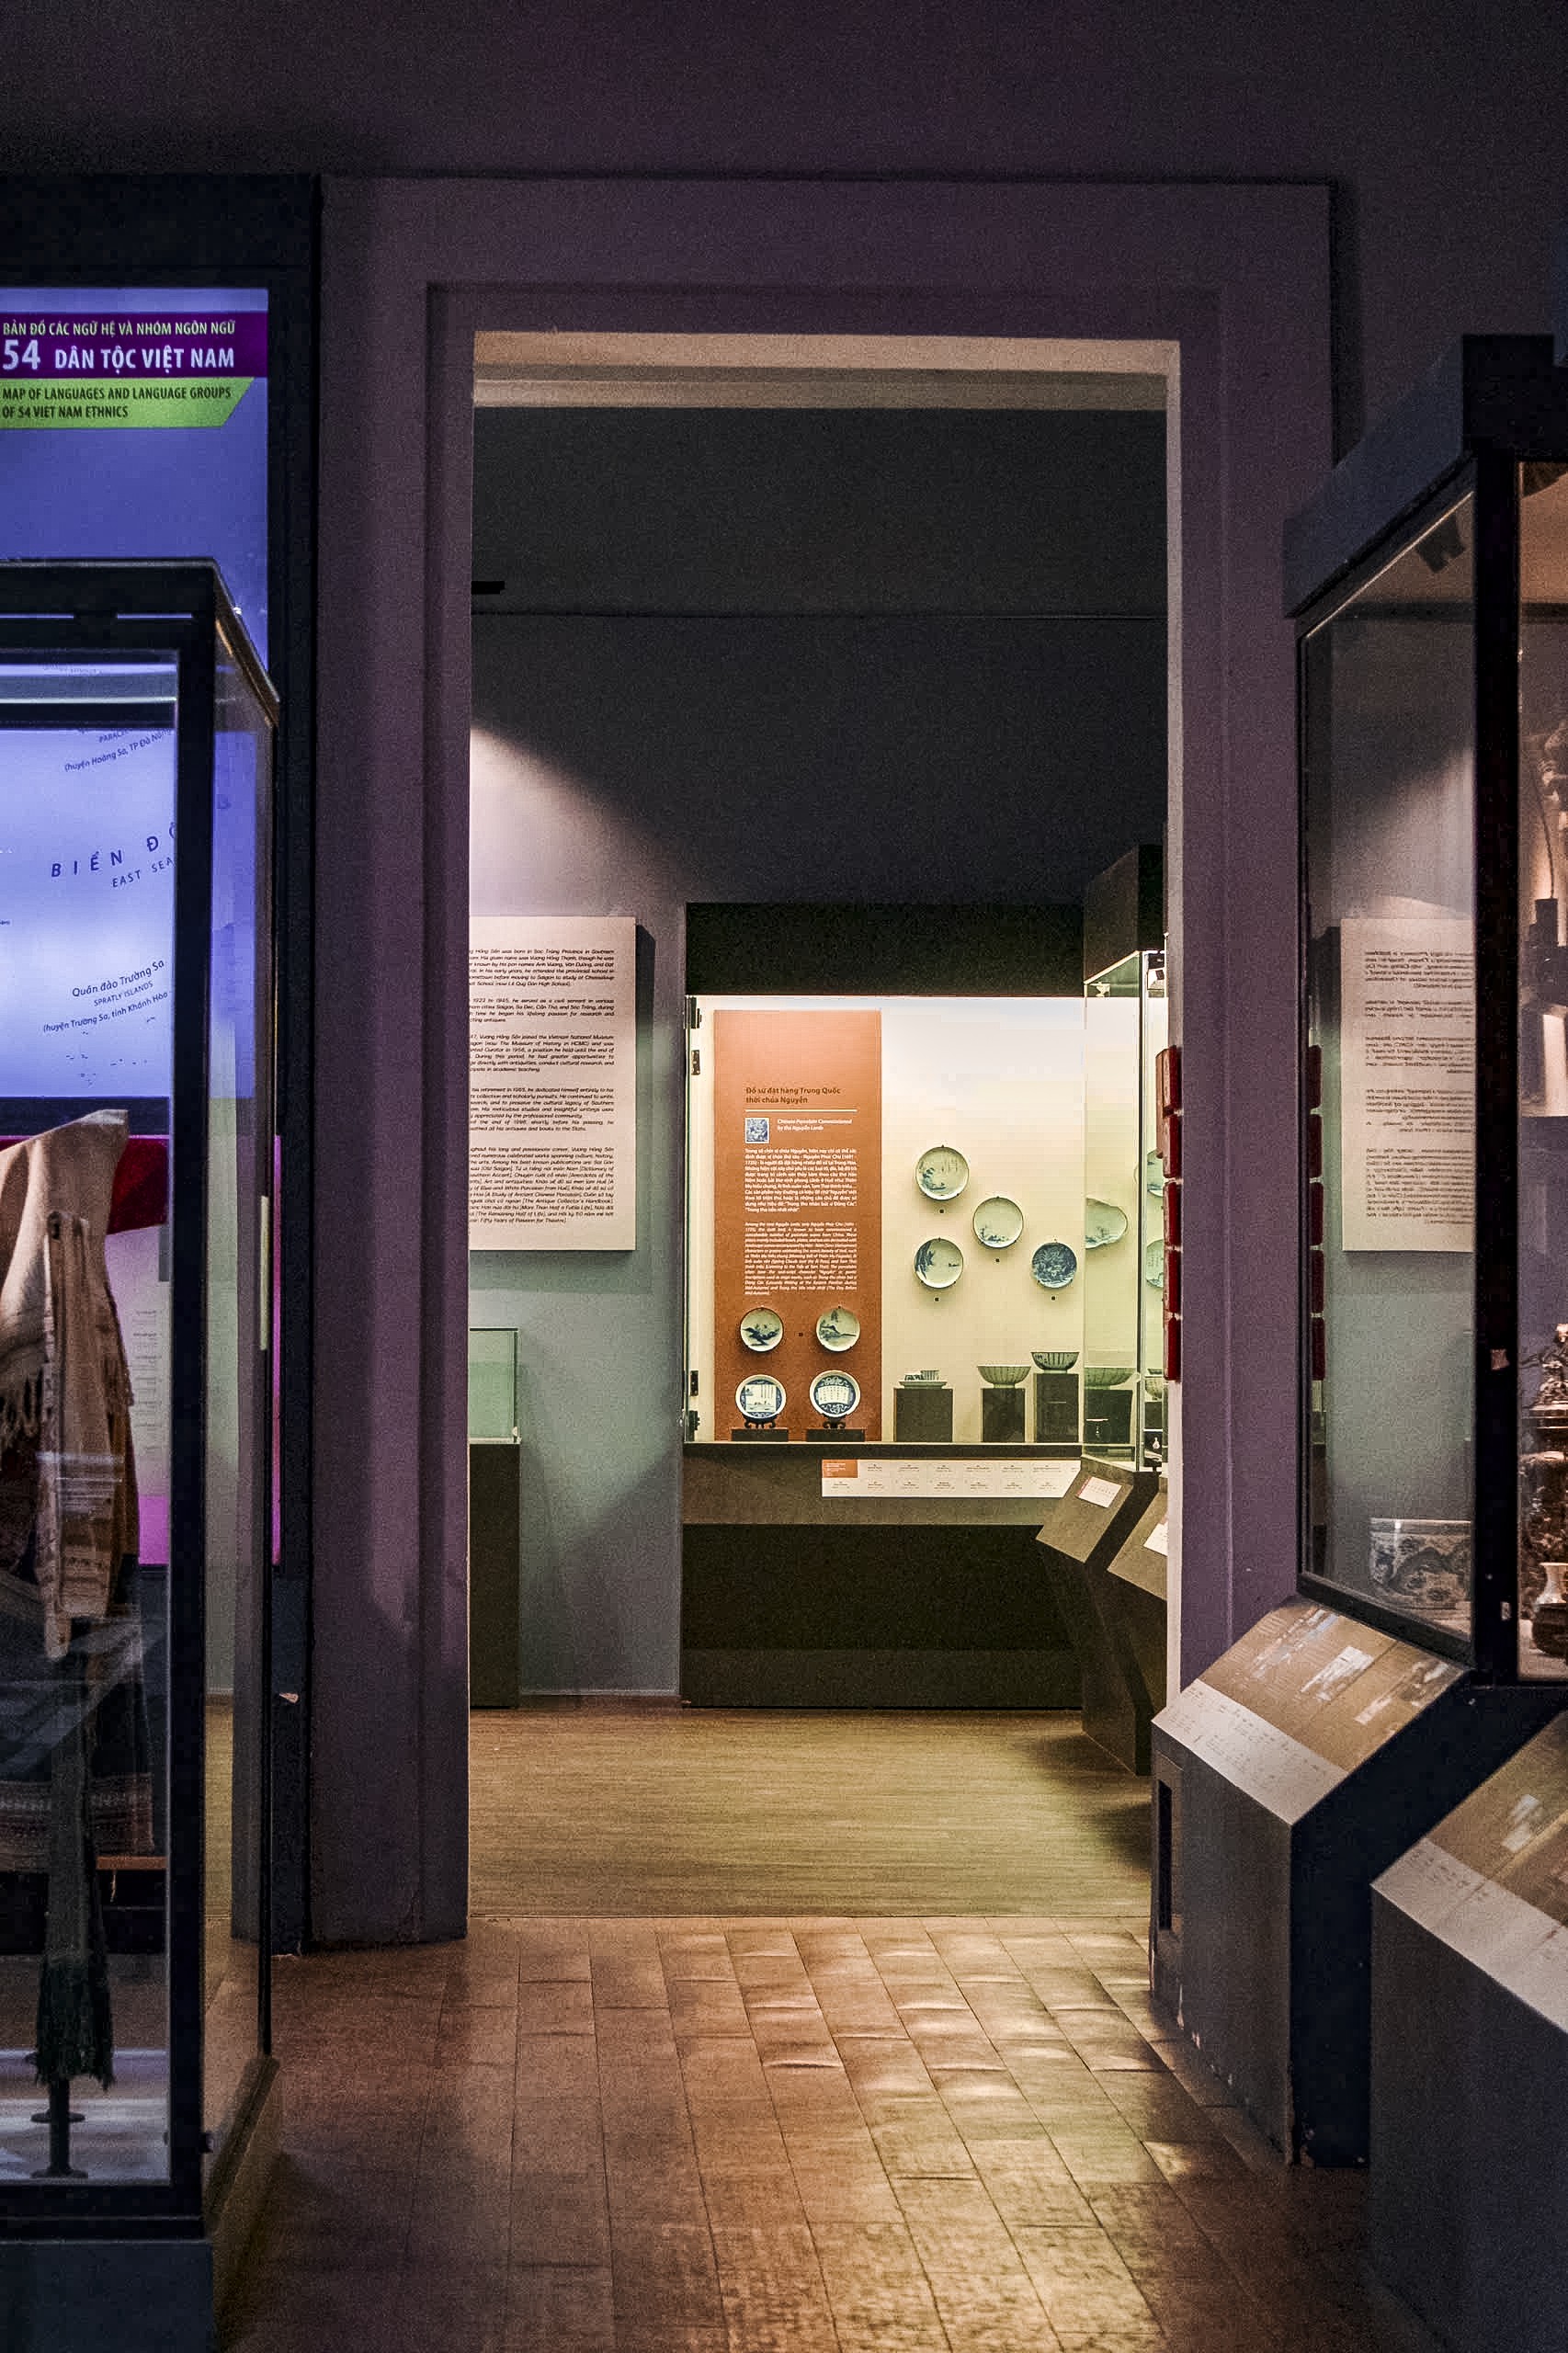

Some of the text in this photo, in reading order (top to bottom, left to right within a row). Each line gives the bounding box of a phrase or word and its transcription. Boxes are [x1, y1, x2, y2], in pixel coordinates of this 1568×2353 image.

[49, 320, 70, 335] CÁC
[136, 320, 172, 335] NHÓM
[175, 320, 208, 335] NGÔN
[2, 339, 234, 375] 54 DÂN TỘC VIỆT NAM
[2, 387, 232, 400] MAP OF LANGUAGES AND LANGUAGE GROUPS
[2, 405, 16, 418] OF
[17, 405, 31, 418] 54
[58, 405, 83, 418] NAM
[85, 405, 129, 418] ETHNICS
[111, 857, 175, 888] EAST SEA
[152, 960, 165, 971] Sa
[124, 980, 153, 998] ISLANDS
[800, 1087, 821, 1096] Trung
